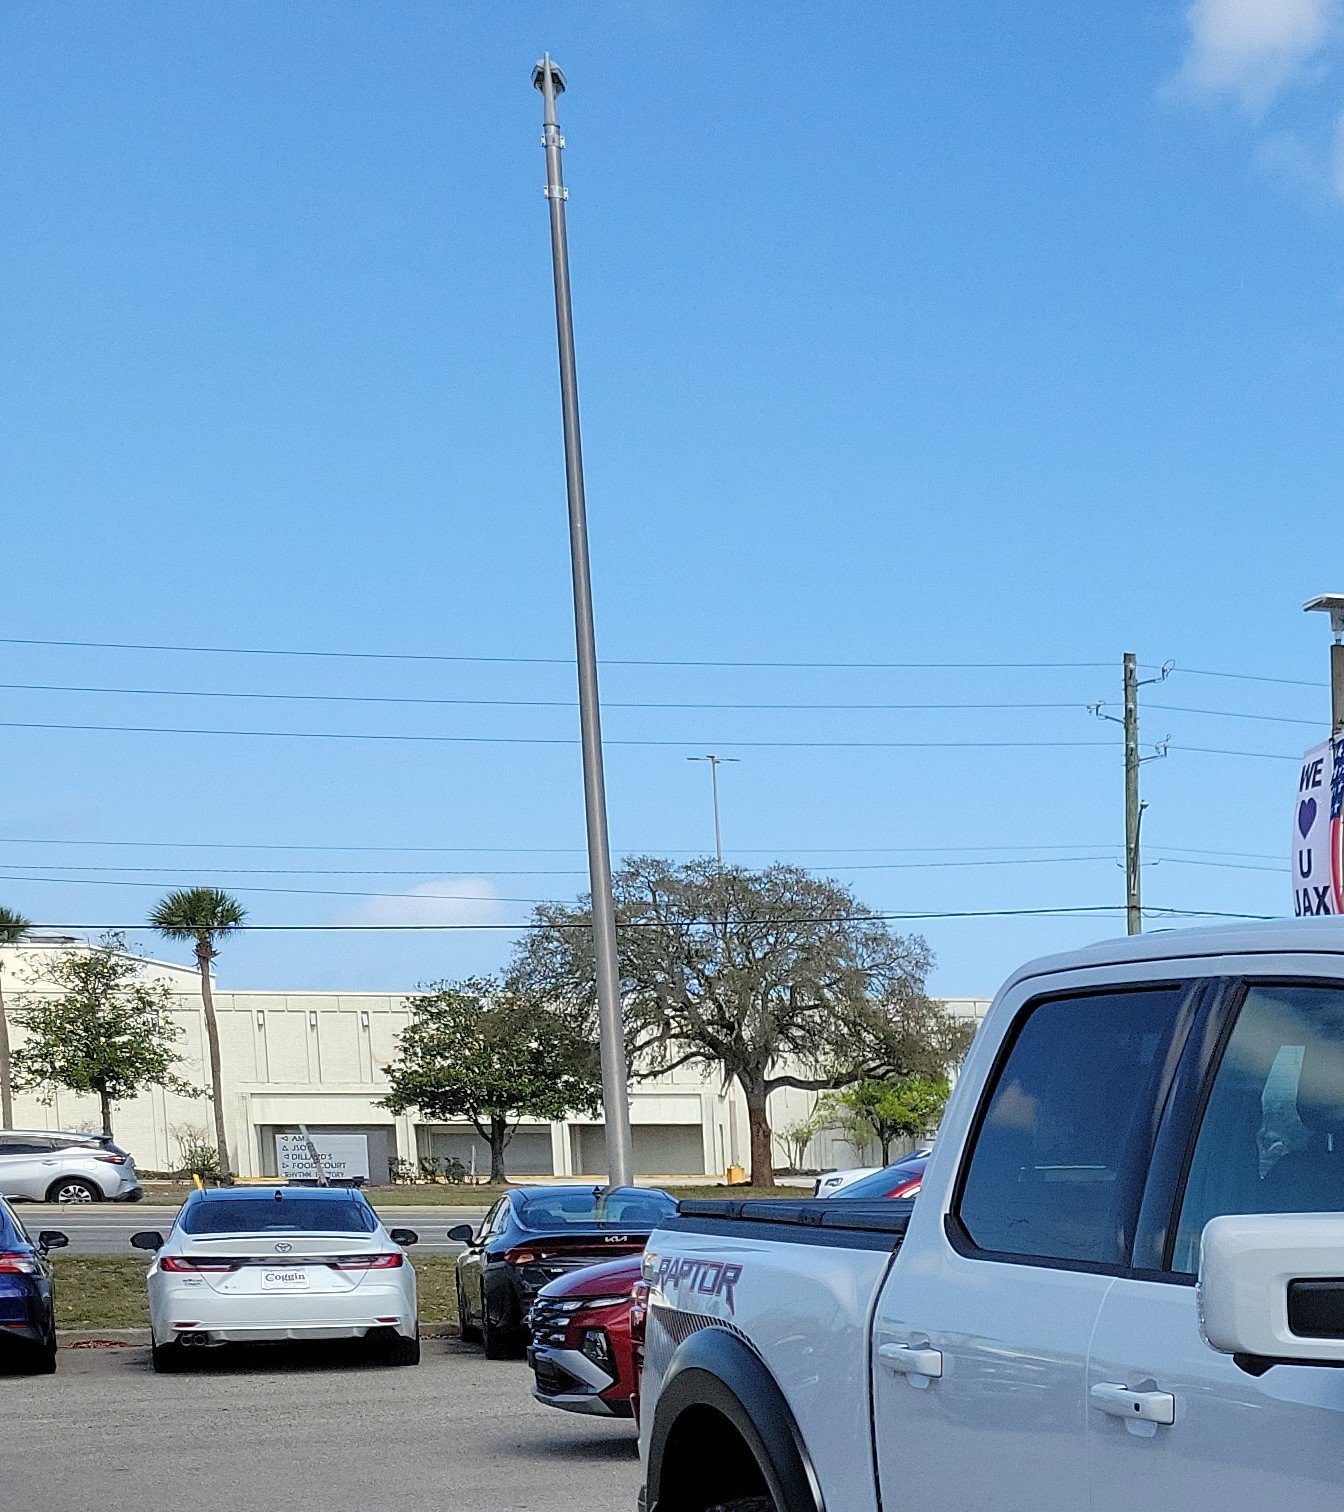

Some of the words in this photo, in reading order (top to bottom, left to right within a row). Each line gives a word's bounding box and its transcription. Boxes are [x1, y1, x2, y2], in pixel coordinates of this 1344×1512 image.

[1299, 757, 1325, 792] WE
[1299, 848, 1312, 879] U
[1294, 885, 1331, 917] JAX
[265, 1272, 306, 1282] Coggin
[656, 1256, 744, 1317] RAPTOR
